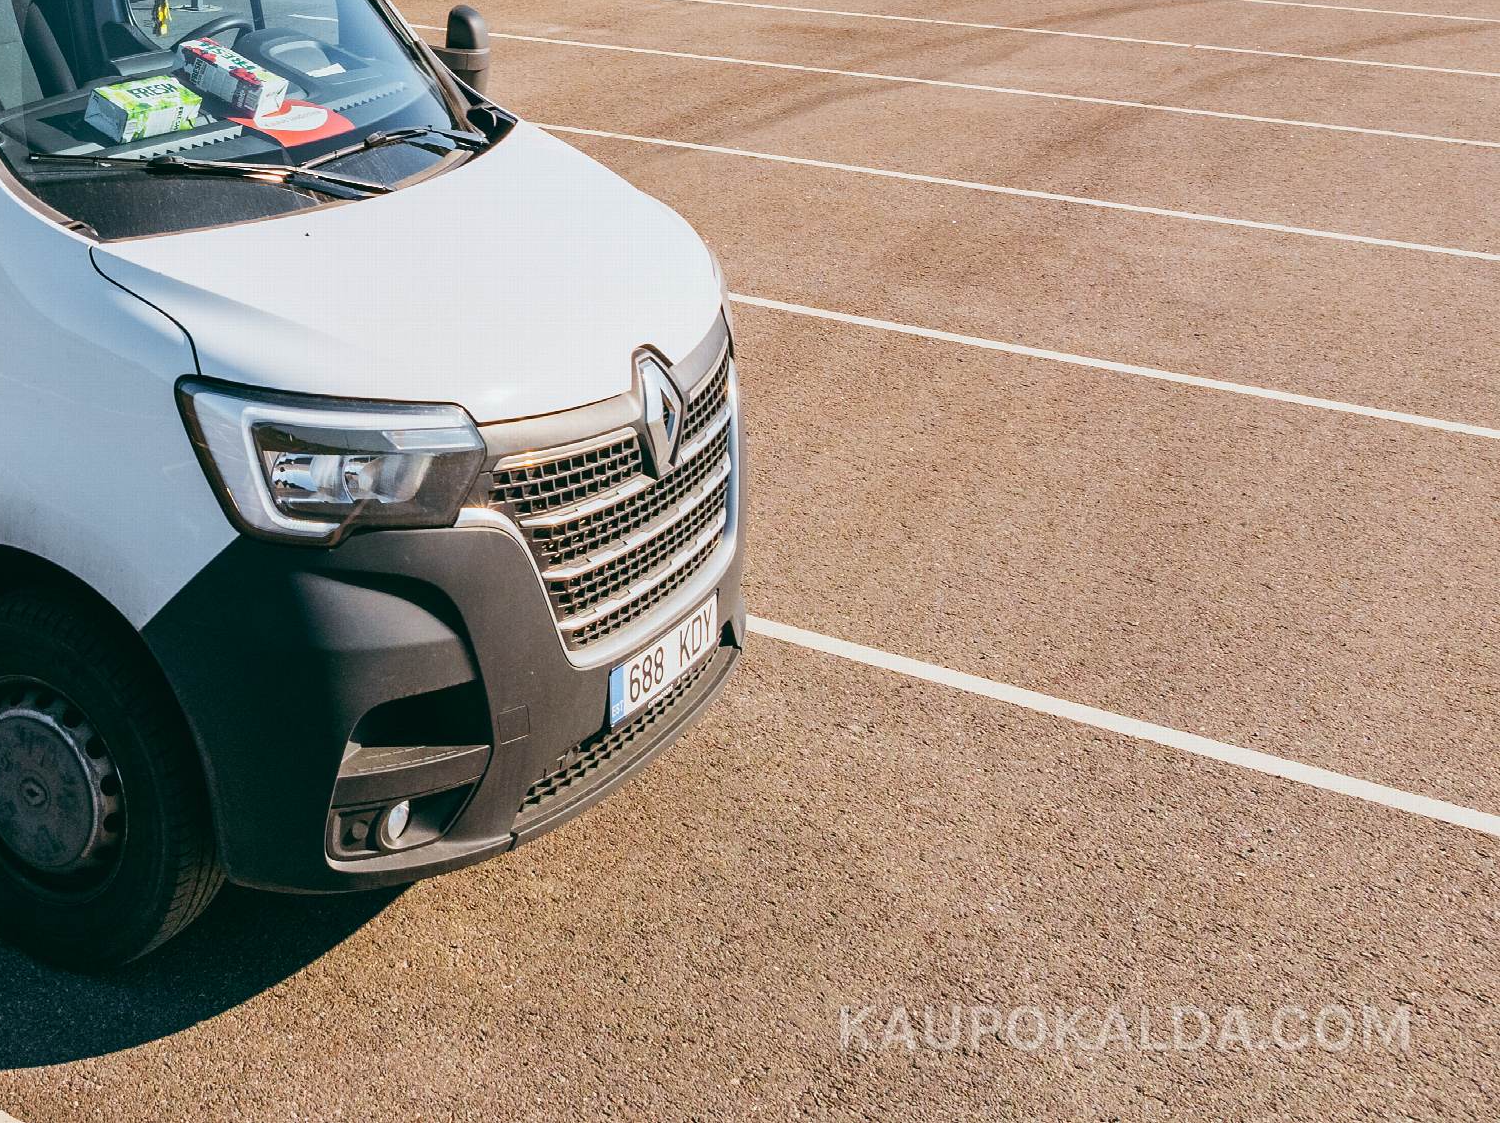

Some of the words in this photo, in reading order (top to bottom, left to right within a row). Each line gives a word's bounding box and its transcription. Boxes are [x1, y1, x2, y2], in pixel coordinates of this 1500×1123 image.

[127, 82, 178, 99] FRESH
[629, 646, 664, 703] 688
[679, 603, 713, 667] KDY
